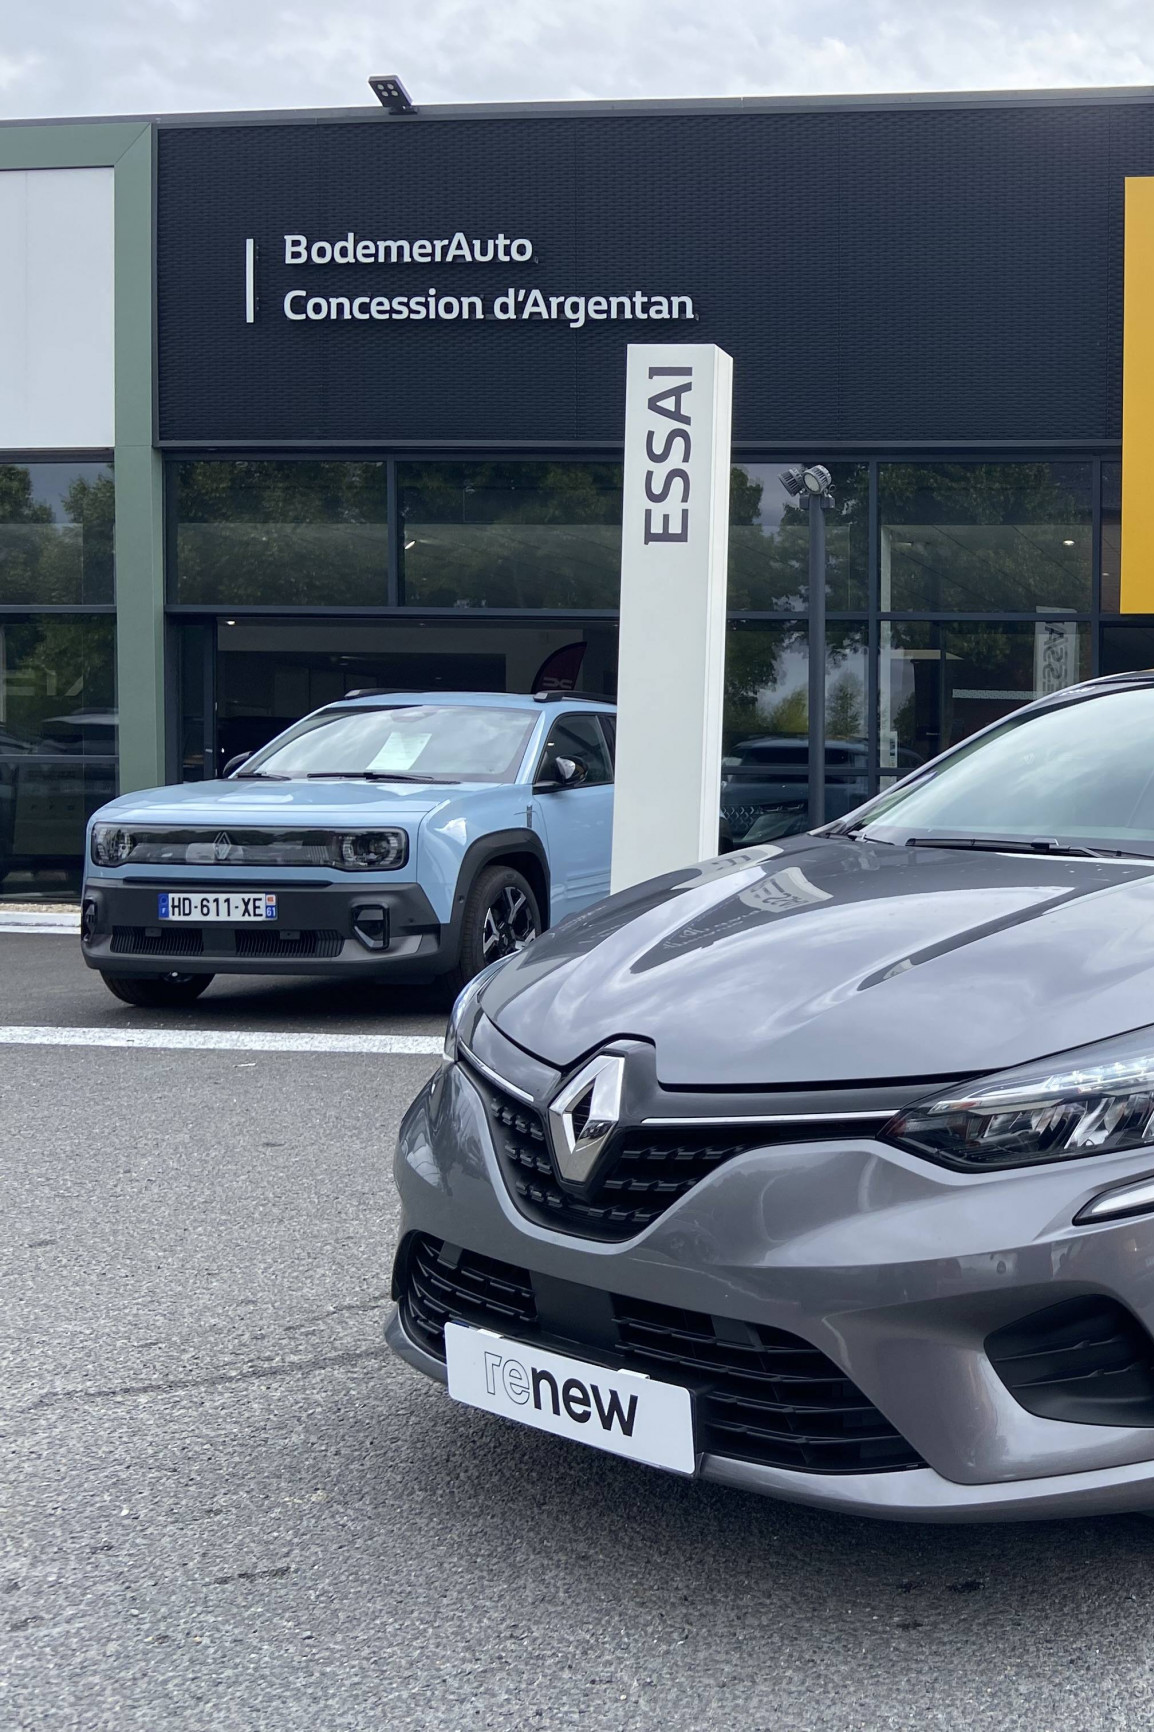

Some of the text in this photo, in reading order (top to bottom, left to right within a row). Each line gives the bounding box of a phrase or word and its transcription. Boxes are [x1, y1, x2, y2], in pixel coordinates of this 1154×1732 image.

[284, 232, 534, 265] BodemerAuto
[284, 288, 695, 328] Concession d'Argentan
[644, 365, 693, 546] ESSAI
[171, 897, 263, 917] HD-611-XE
[266, 907, 276, 917] 61
[483, 1350, 639, 1438] renew
